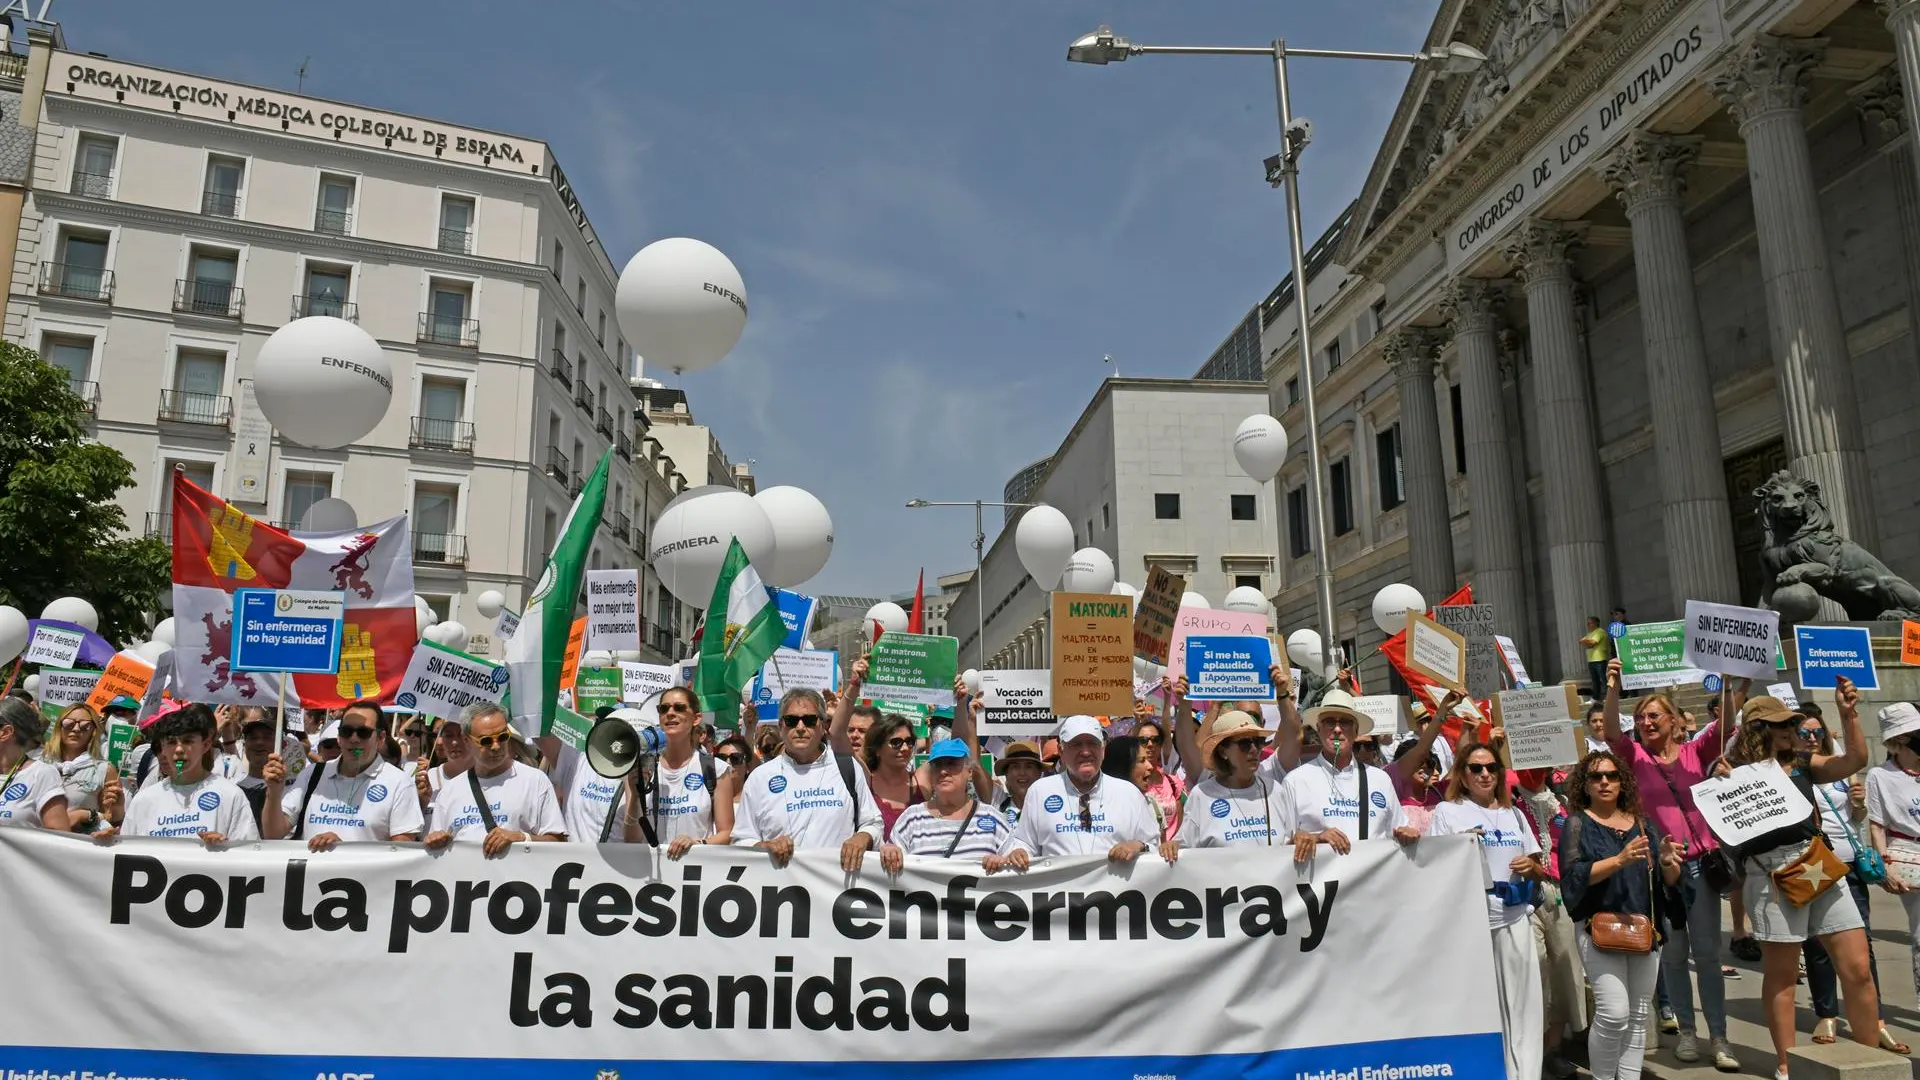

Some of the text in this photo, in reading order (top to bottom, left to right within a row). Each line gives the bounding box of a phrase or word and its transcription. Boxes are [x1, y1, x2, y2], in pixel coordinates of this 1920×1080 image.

[68, 65, 524, 163] ORGANIZACIÓN MÉDICA COLEGIAL DE ESPAÑA
[1459, 26, 1703, 251] CONGRESO DE LOS DIPUTADOS
[590, 580, 637, 597] Más enfermer@s
[1153, 572, 1169, 593] NO
[593, 601, 636, 617] con mejor trato
[1069, 602, 1128, 618] MATRONA
[1435, 605, 1493, 623] MATRONAS
[247, 620, 327, 633] Sin enfermeras
[592, 620, 637, 638] y remuneración.
[1181, 616, 1231, 631] GRUPO
[1241, 623, 1253, 635] A
[1697, 615, 1712, 632] SIN
[1712, 617, 1768, 640] ENFERMERAS
[36, 629, 47, 641] Por
[54, 634, 80, 648] derecho
[246, 633, 326, 646] no hay sanidad
[1061, 634, 1121, 645] MALTRATADA
[1642, 635, 1680, 644] matrona,
[36, 646, 47, 657] por
[45, 648, 54, 657] tu
[878, 646, 928, 658] Tu matrona,
[1203, 651, 1213, 659] Si
[1232, 651, 1249, 659] has
[1631, 647, 1650, 656] junto
[1694, 637, 1769, 665] NO HAY CUIDADOS.
[1808, 648, 1858, 658] Enfermeras
[876, 656, 897, 665] junto
[1063, 655, 1130, 664] PLAN DE MEJORA
[1647, 654, 1668, 662] largo
[1805, 659, 1865, 669] por la sanidad
[891, 666, 912, 675] largo
[1202, 661, 1253, 671] aplaudido
[1634, 663, 1654, 671] toda
[49, 674, 60, 685] SIN
[426, 656, 500, 694] SIN ENFERMERAS
[624, 669, 672, 684] SIN ENFERMERAS
[876, 674, 895, 682] toda
[908, 676, 926, 685] vida
[1204, 673, 1253, 683] ¡Apóyame,
[585, 678, 604, 686] Grupo
[413, 677, 450, 702] NO HAY
[629, 684, 642, 693] HAY
[995, 687, 1043, 697] Vocación
[1193, 684, 1266, 694] te necesitamos!
[46, 689, 67, 701] NO HAY
[1078, 692, 1111, 702] MADRID
[1005, 698, 1033, 706] no es
[1509, 727, 1562, 736] FISIOTERAPEUTAS
[1752, 779, 1768, 790] sin
[794, 788, 834, 799] Unidad
[1764, 787, 1778, 797] no
[658, 794, 689, 805] nidad
[320, 803, 361, 815] Unidad
[786, 800, 844, 812] Enfermera
[1721, 795, 1786, 824] merecéis ser
[158, 812, 200, 825] Unidad
[309, 814, 365, 827] Enfermera
[1734, 806, 1789, 830] Diputados
[111, 857, 1339, 953] Por la profesión enfermera y
[510, 953, 970, 1032] la sanidad
[1296, 1064, 1453, 1080] Unidad Enfermera
